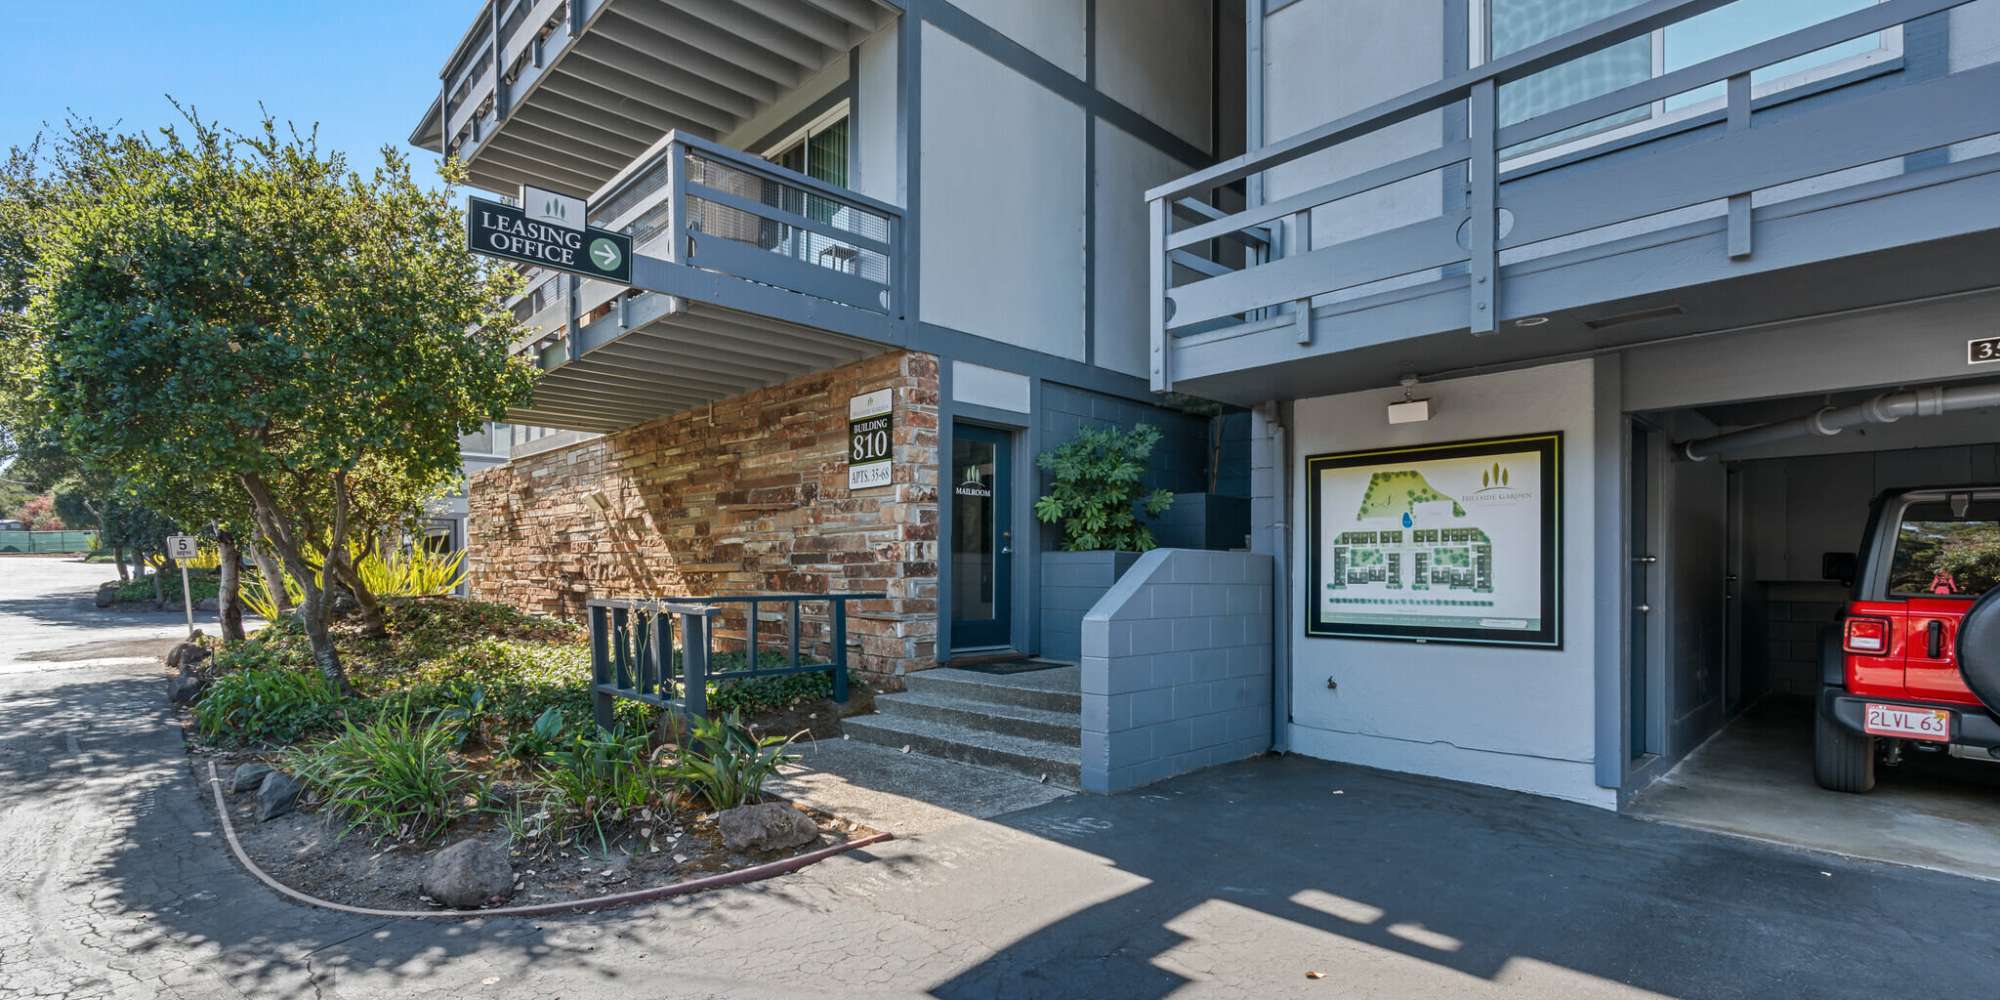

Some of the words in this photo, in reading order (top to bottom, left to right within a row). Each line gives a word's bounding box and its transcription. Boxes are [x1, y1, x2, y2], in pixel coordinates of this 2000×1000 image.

[481, 211, 582, 249] LEASING
[490, 233, 575, 265] OFFICE
[853, 418, 888, 434] BUILDING
[853, 430, 888, 460] 810
[955, 487, 991, 497] MAILROOM
[178, 539, 187, 550] 5
[1870, 711, 1915, 729] 2LVL
